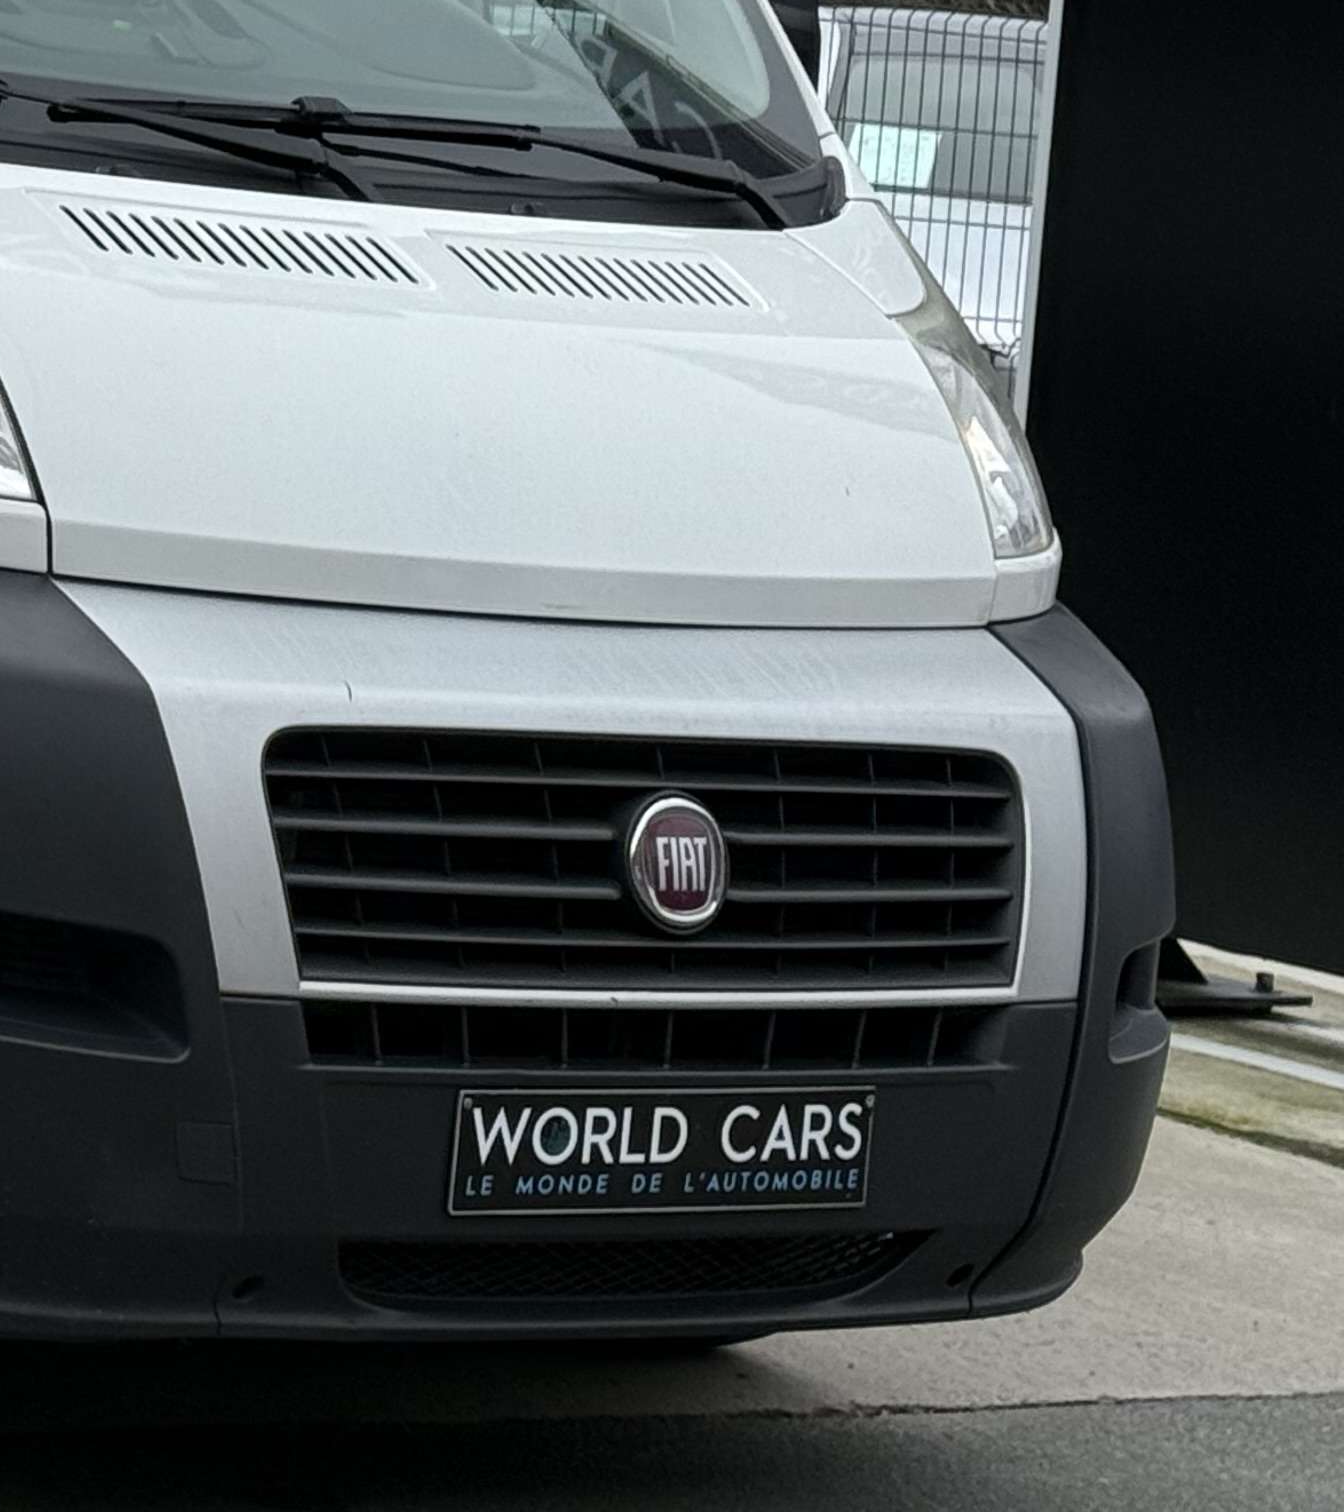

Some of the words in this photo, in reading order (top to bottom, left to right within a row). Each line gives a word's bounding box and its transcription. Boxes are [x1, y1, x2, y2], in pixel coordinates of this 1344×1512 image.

[655, 836, 707, 892] FIAT
[472, 1106, 689, 1166] WORLD
[720, 1103, 863, 1165] CARS
[464, 1174, 494, 1197] LE
[514, 1172, 609, 1196] MONDE
[630, 1172, 662, 1195] DE
[682, 1168, 859, 1194] L'AUTOMOBILE
